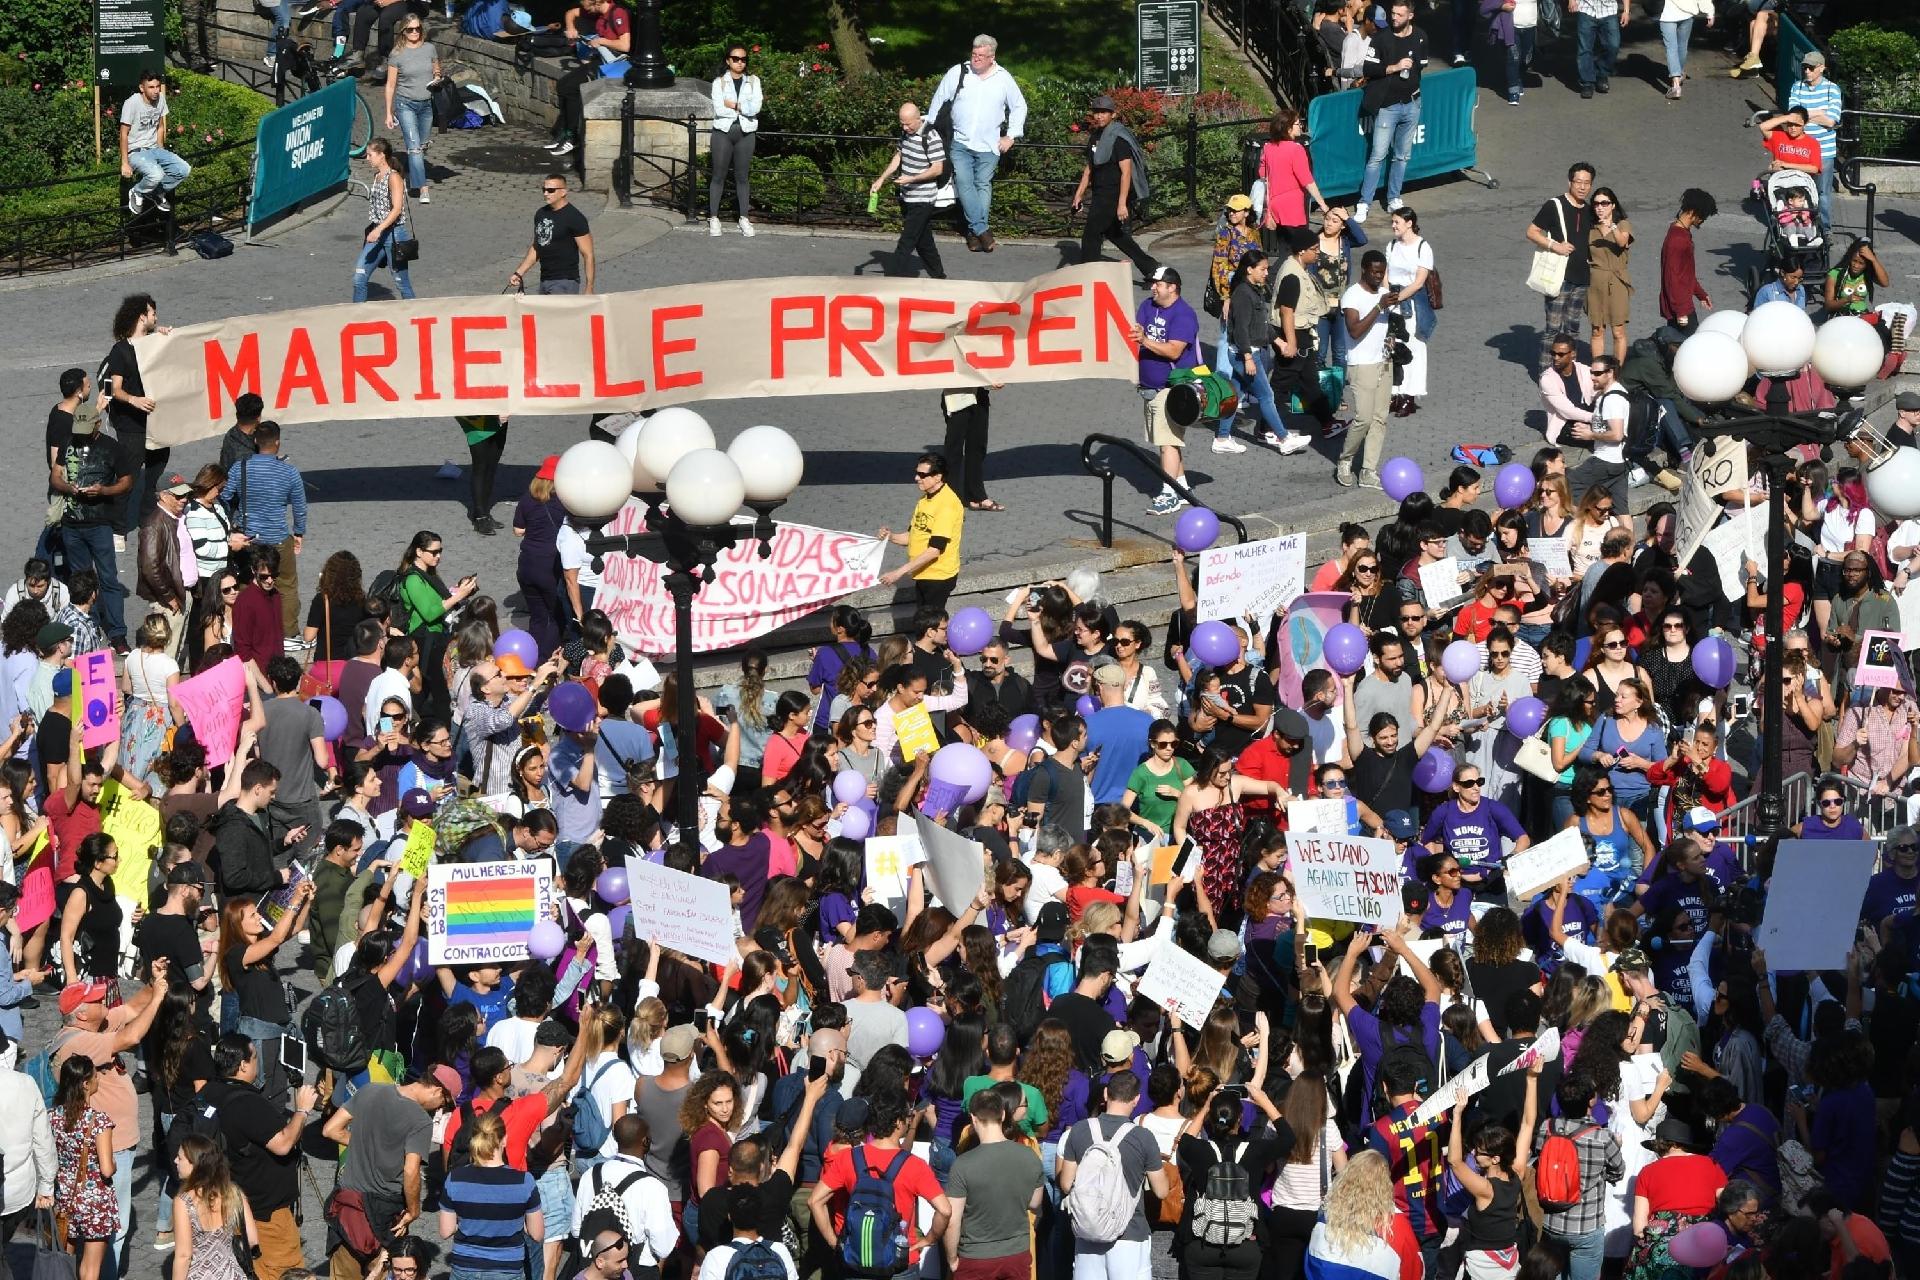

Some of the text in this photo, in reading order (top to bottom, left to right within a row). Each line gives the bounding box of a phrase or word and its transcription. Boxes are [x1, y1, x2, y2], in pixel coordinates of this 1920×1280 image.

[292, 110, 316, 128] WELCOME
[285, 124, 312, 152] UNION
[291, 137, 325, 169] SQUARE
[204, 281, 1139, 419] MARIELLE PRESEN
[1234, 544, 1267, 560] MULHER
[604, 554, 658, 597] CONTRA
[1452, 825, 1484, 837] WOMEN
[1295, 839, 1370, 866] WE STAND
[1307, 868, 1349, 888] AGAINST
[1355, 870, 1400, 896] FASCISM
[430, 888, 446, 902] 29
[1677, 896, 1705, 907] WOME
[1895, 893, 1916, 904] WOM
[430, 903, 446, 918] 09
[430, 920, 446, 935] 18
[443, 946, 491, 960] CONTRA
[1400, 1131, 1442, 1186] 11
